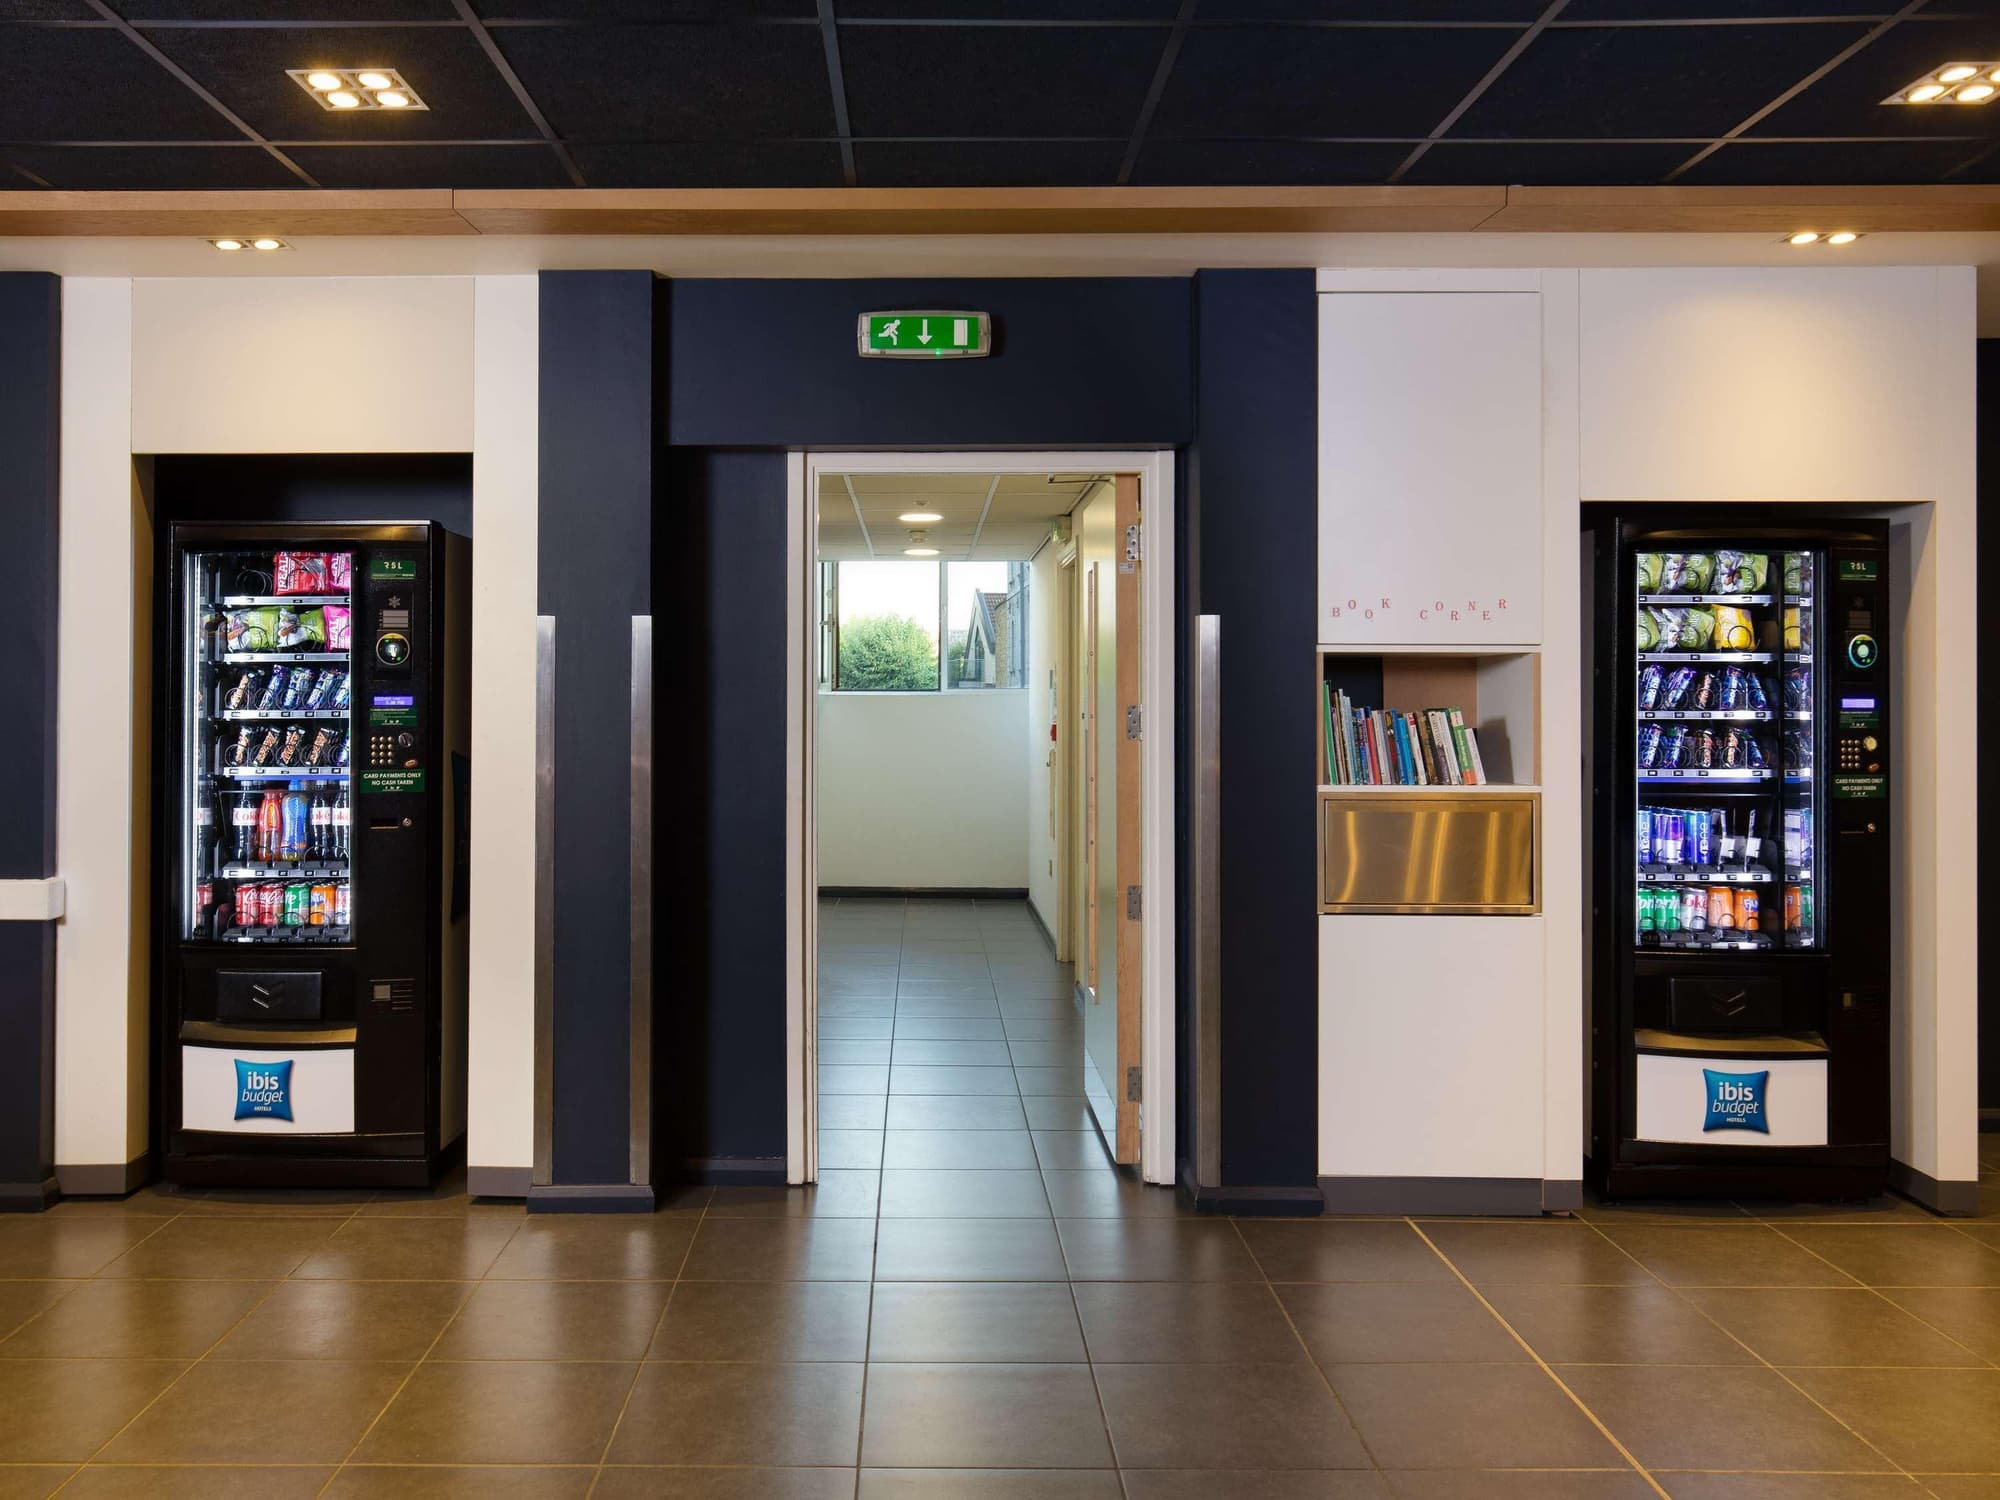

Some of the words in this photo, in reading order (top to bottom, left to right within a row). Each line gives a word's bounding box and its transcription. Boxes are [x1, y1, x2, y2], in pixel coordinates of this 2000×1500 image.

[278, 556, 289, 588] REAL
[1332, 598, 1390, 620] BOOK
[1419, 598, 1507, 621] CORNER
[248, 1071, 279, 1090] ibis
[242, 1088, 285, 1106] budget
[1718, 1081, 1754, 1102] ibis
[1712, 1099, 1760, 1117] budget
